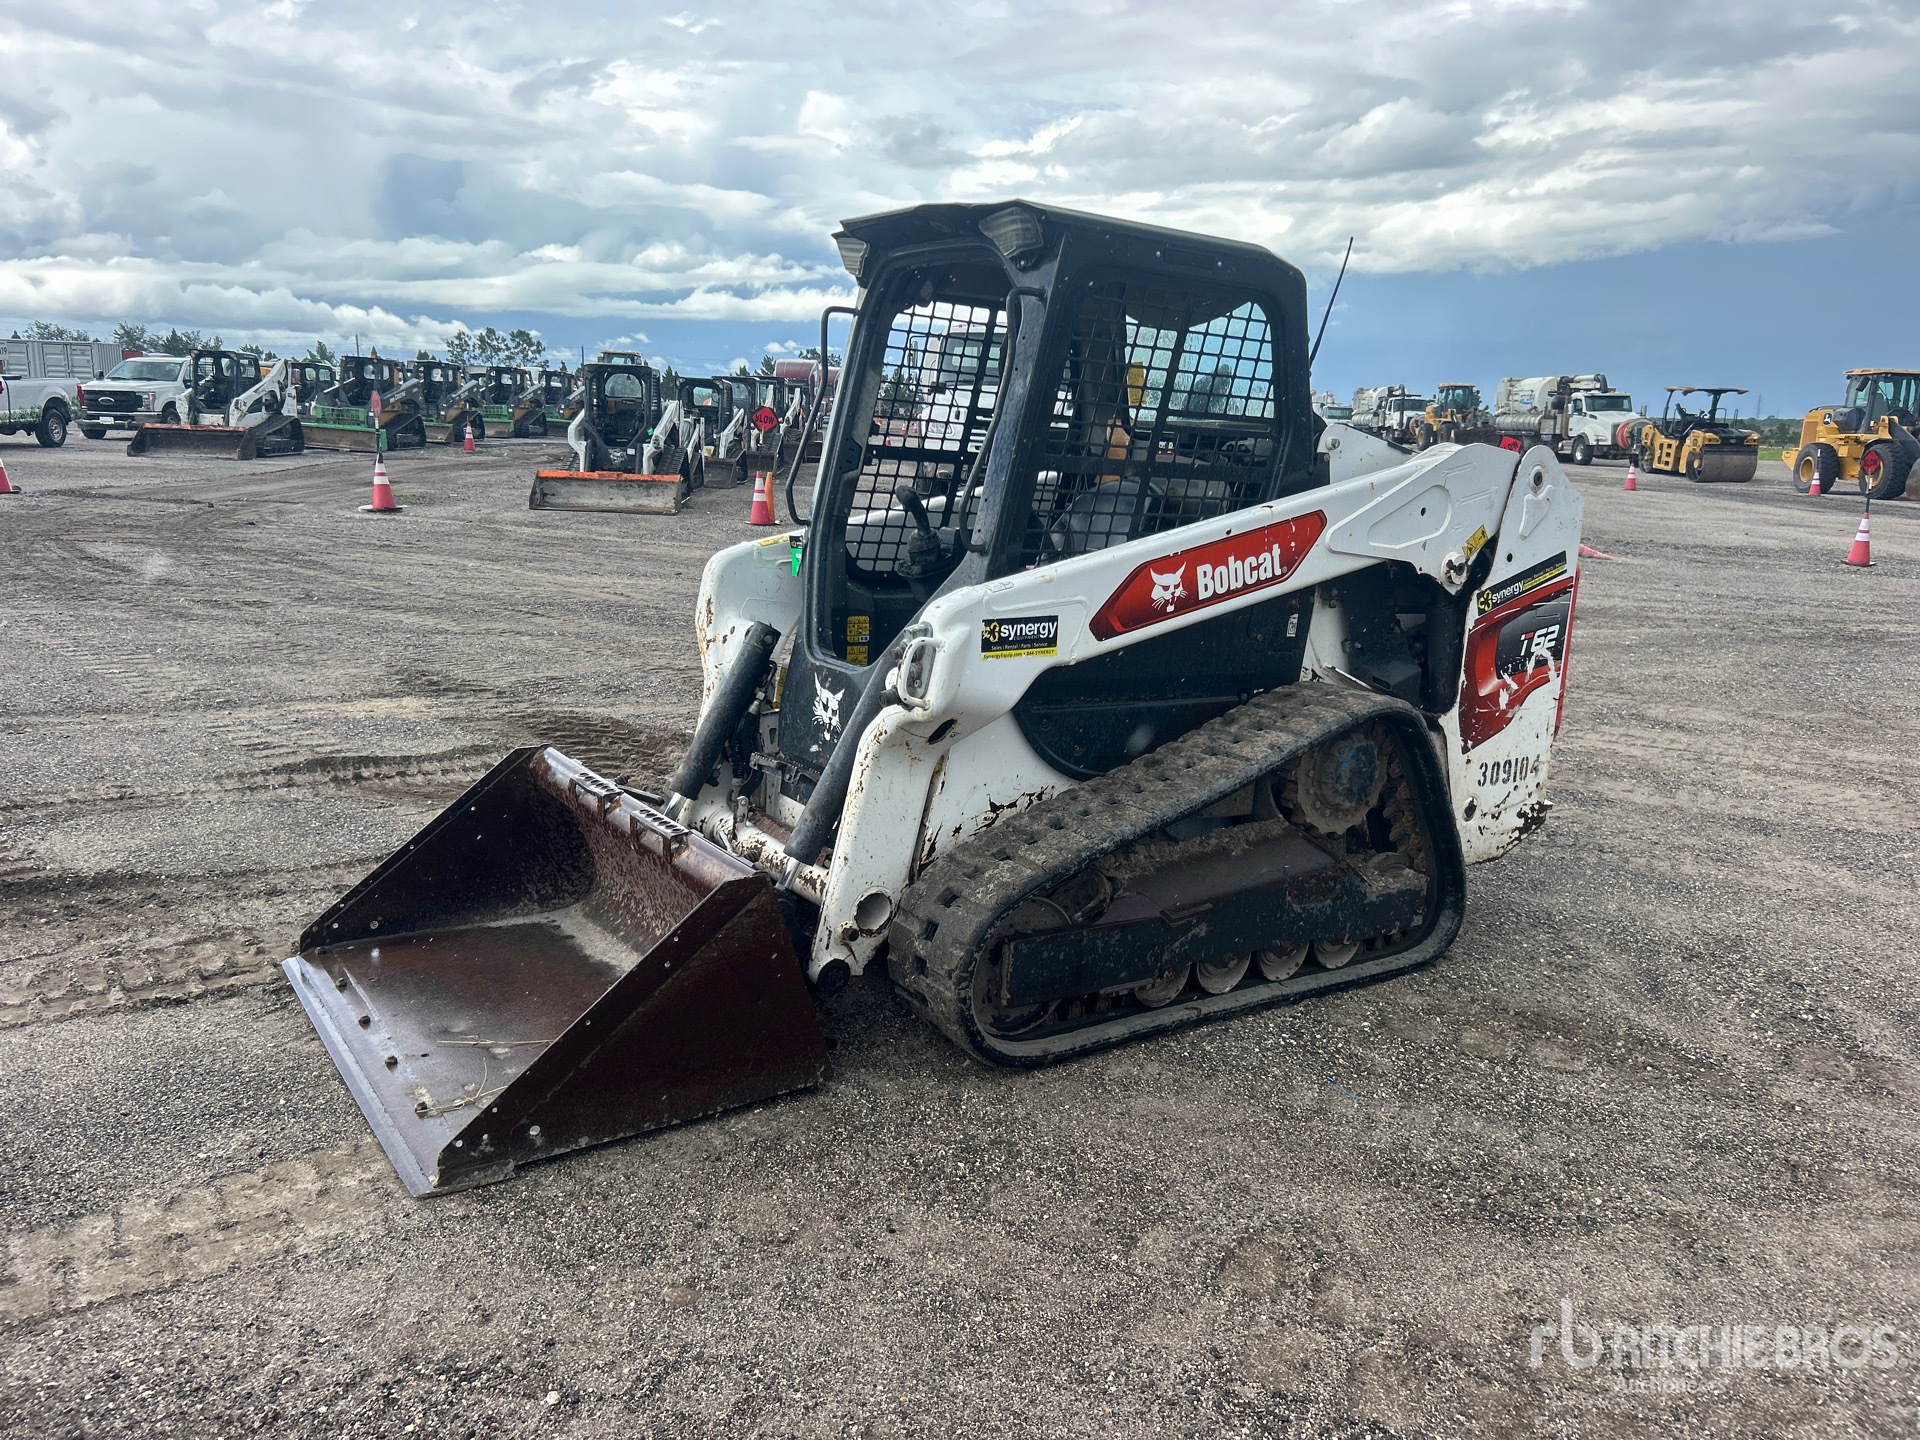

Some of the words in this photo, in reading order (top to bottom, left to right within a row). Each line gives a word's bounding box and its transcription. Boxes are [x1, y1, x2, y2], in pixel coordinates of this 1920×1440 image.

[755, 413, 775, 427] SLOW
[1862, 458, 1879, 468] SLOW
[1196, 543, 1281, 601] Bobcat
[1492, 580, 1525, 604] synergy
[1000, 621, 1057, 641] synergy
[1520, 624, 1560, 657] T62
